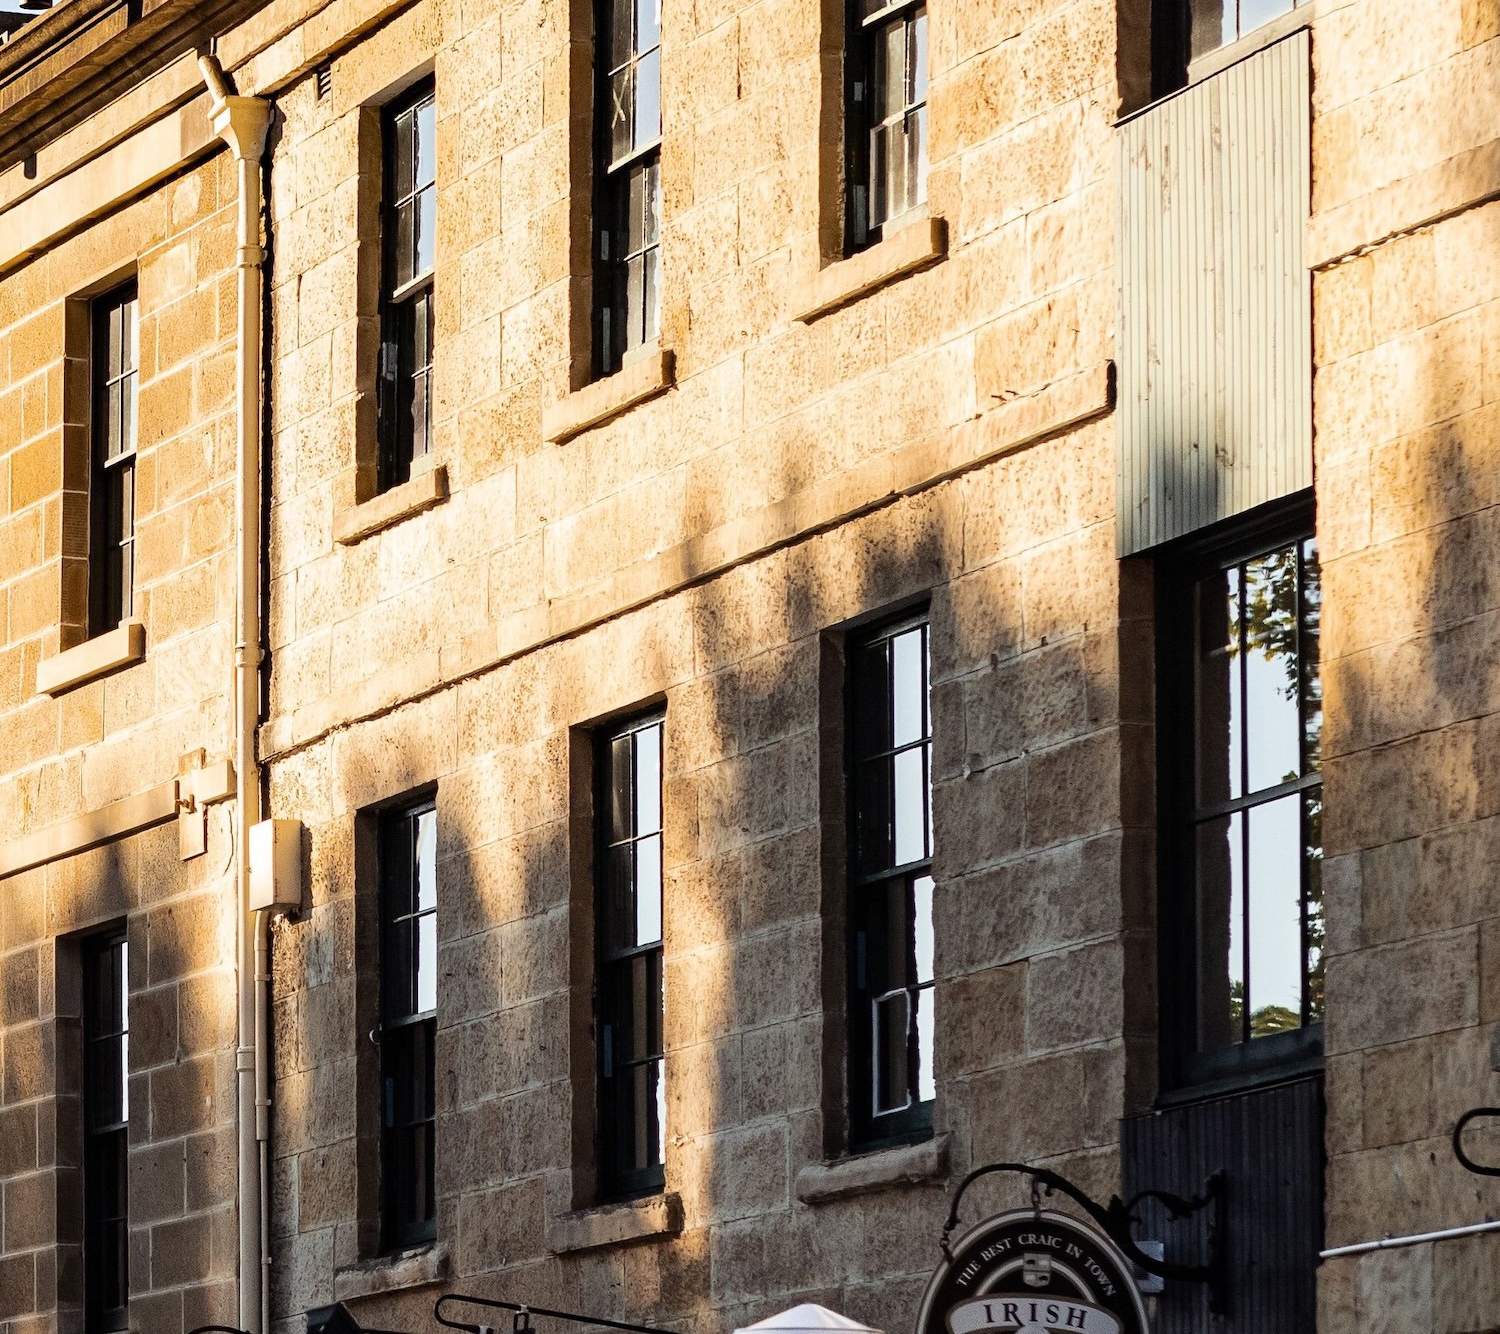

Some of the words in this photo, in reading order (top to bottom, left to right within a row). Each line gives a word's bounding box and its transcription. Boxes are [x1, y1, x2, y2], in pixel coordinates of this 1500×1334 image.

[956, 1260, 982, 1288] THE
[980, 1237, 1012, 1262] BEST
[1018, 1233, 1063, 1250] CRAIC
[1065, 1241, 1084, 1260] IN
[1085, 1256, 1117, 1298] TOWN
[983, 1302, 1088, 1329] IRISH
